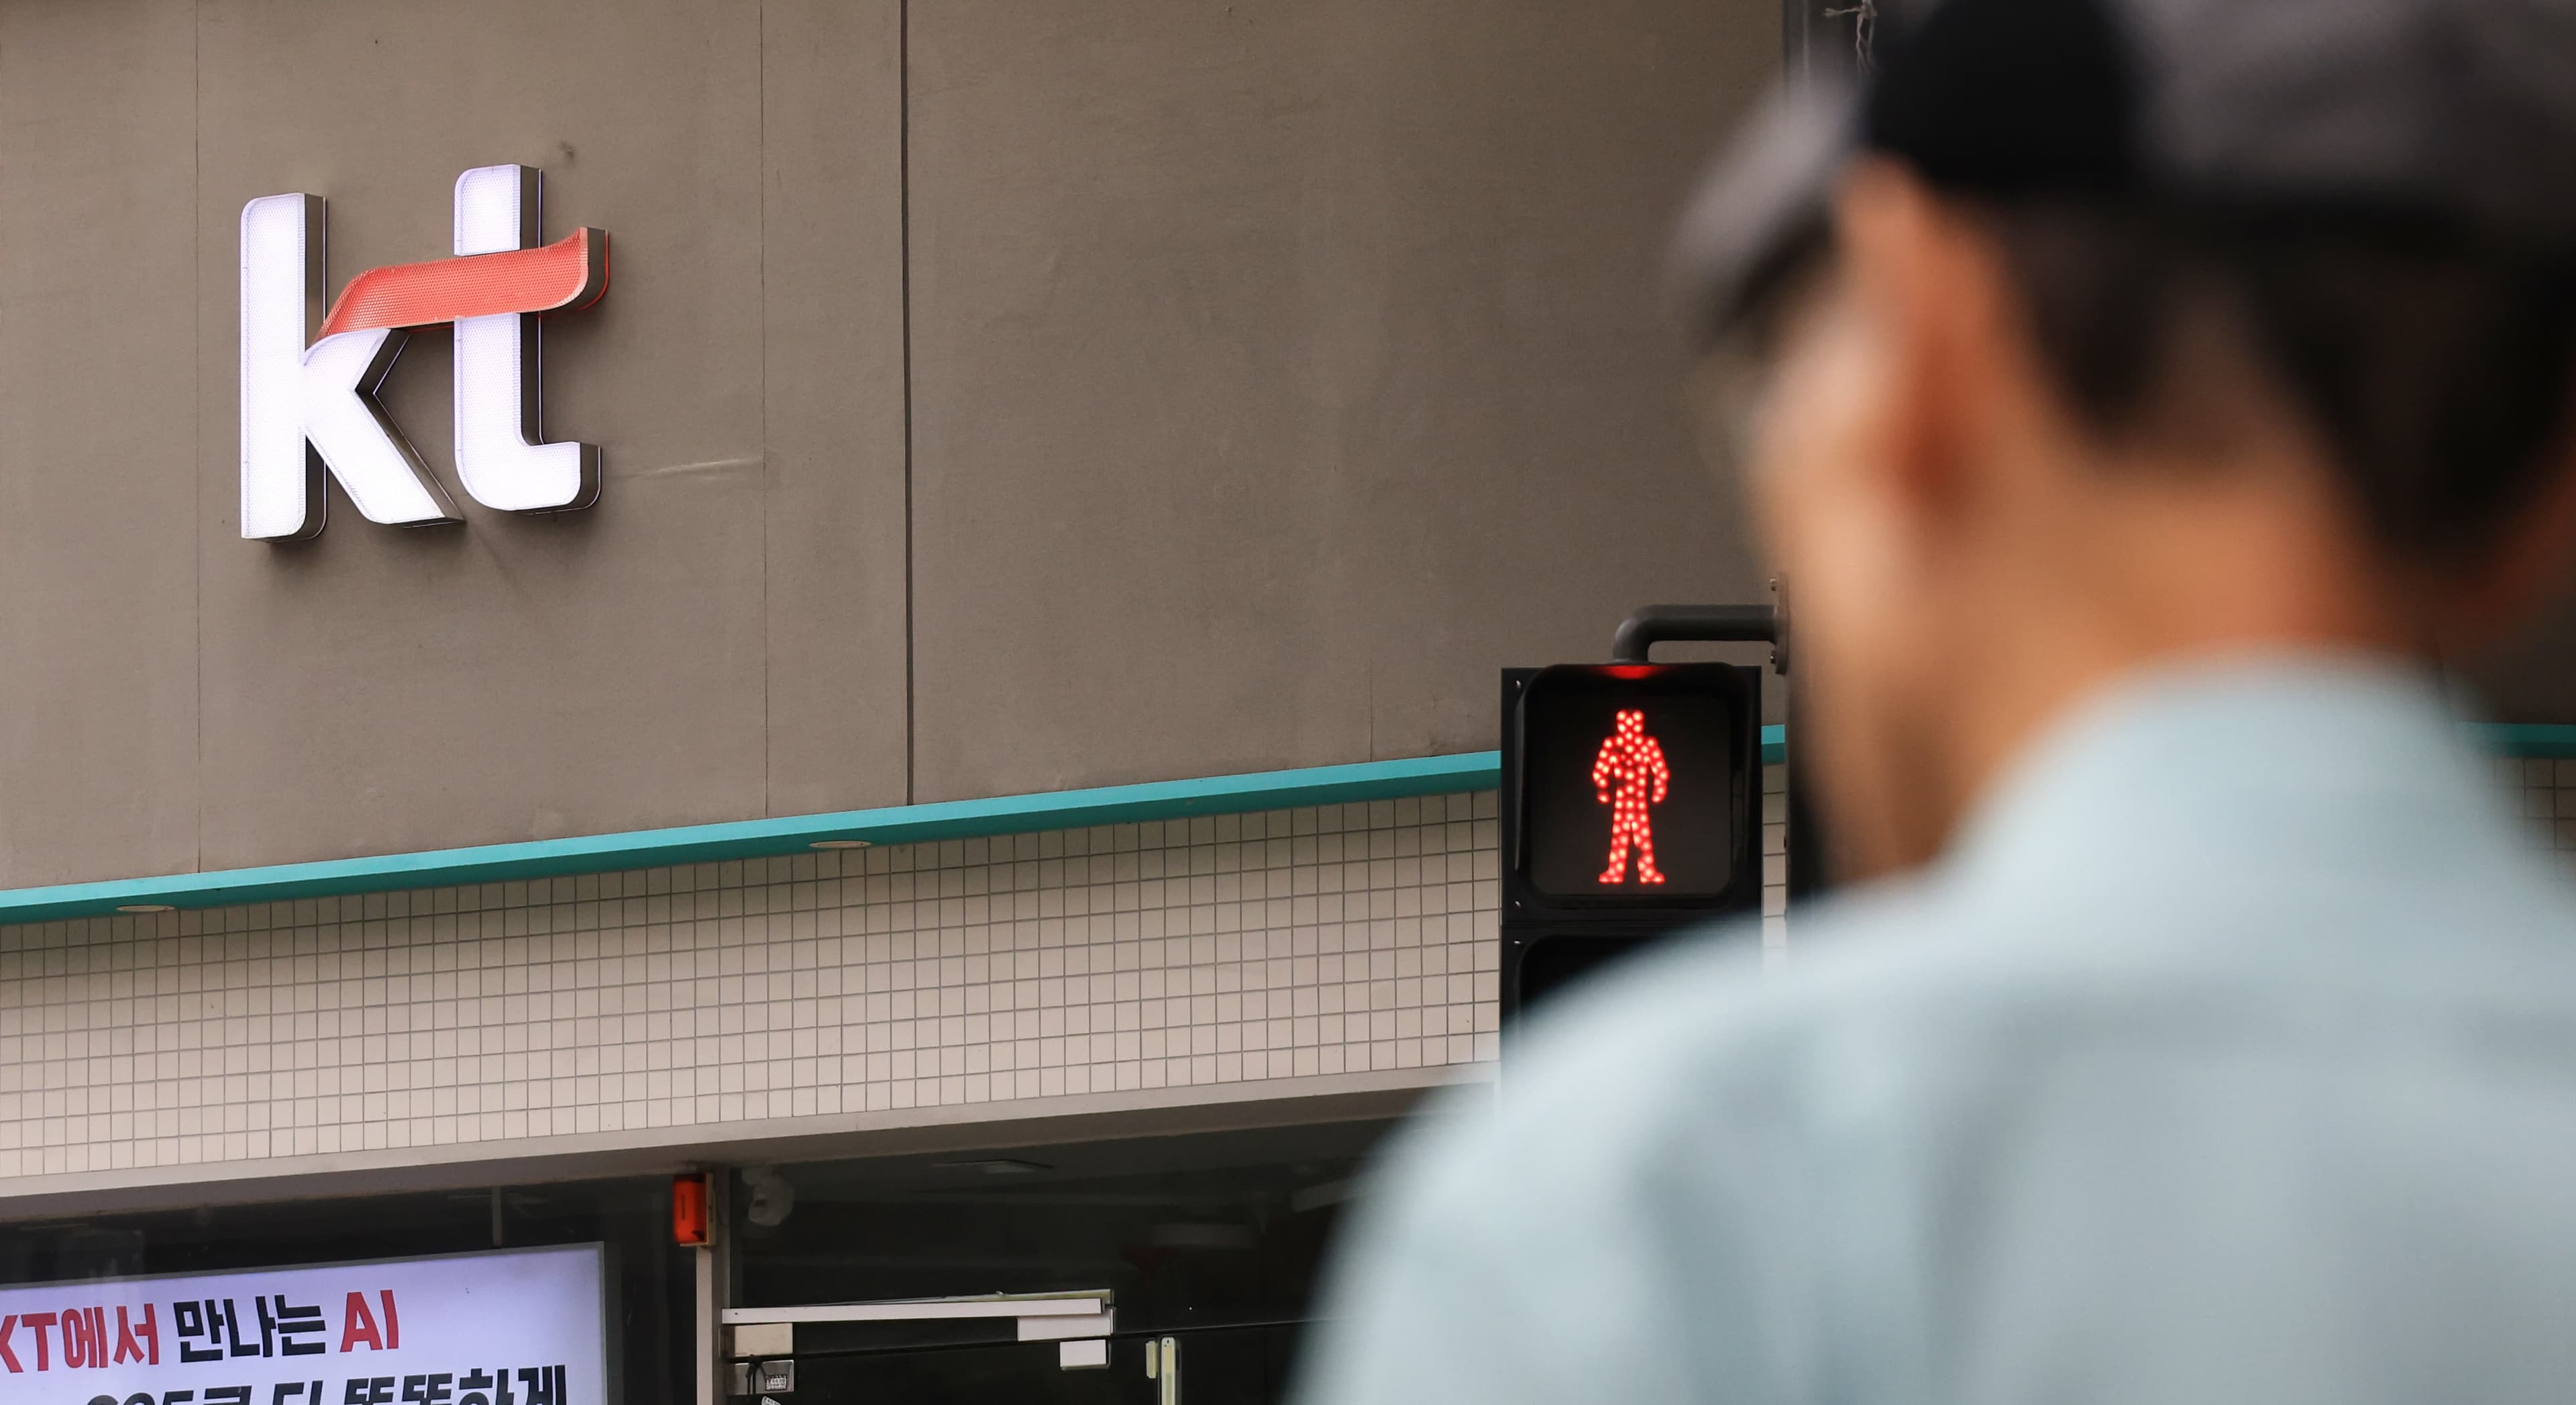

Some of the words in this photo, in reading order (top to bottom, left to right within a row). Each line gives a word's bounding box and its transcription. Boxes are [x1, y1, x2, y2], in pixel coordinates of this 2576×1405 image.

[241, 164, 609, 540] kt
[173, 1294, 326, 1363] 만나는
[339, 1290, 399, 1353] AI
